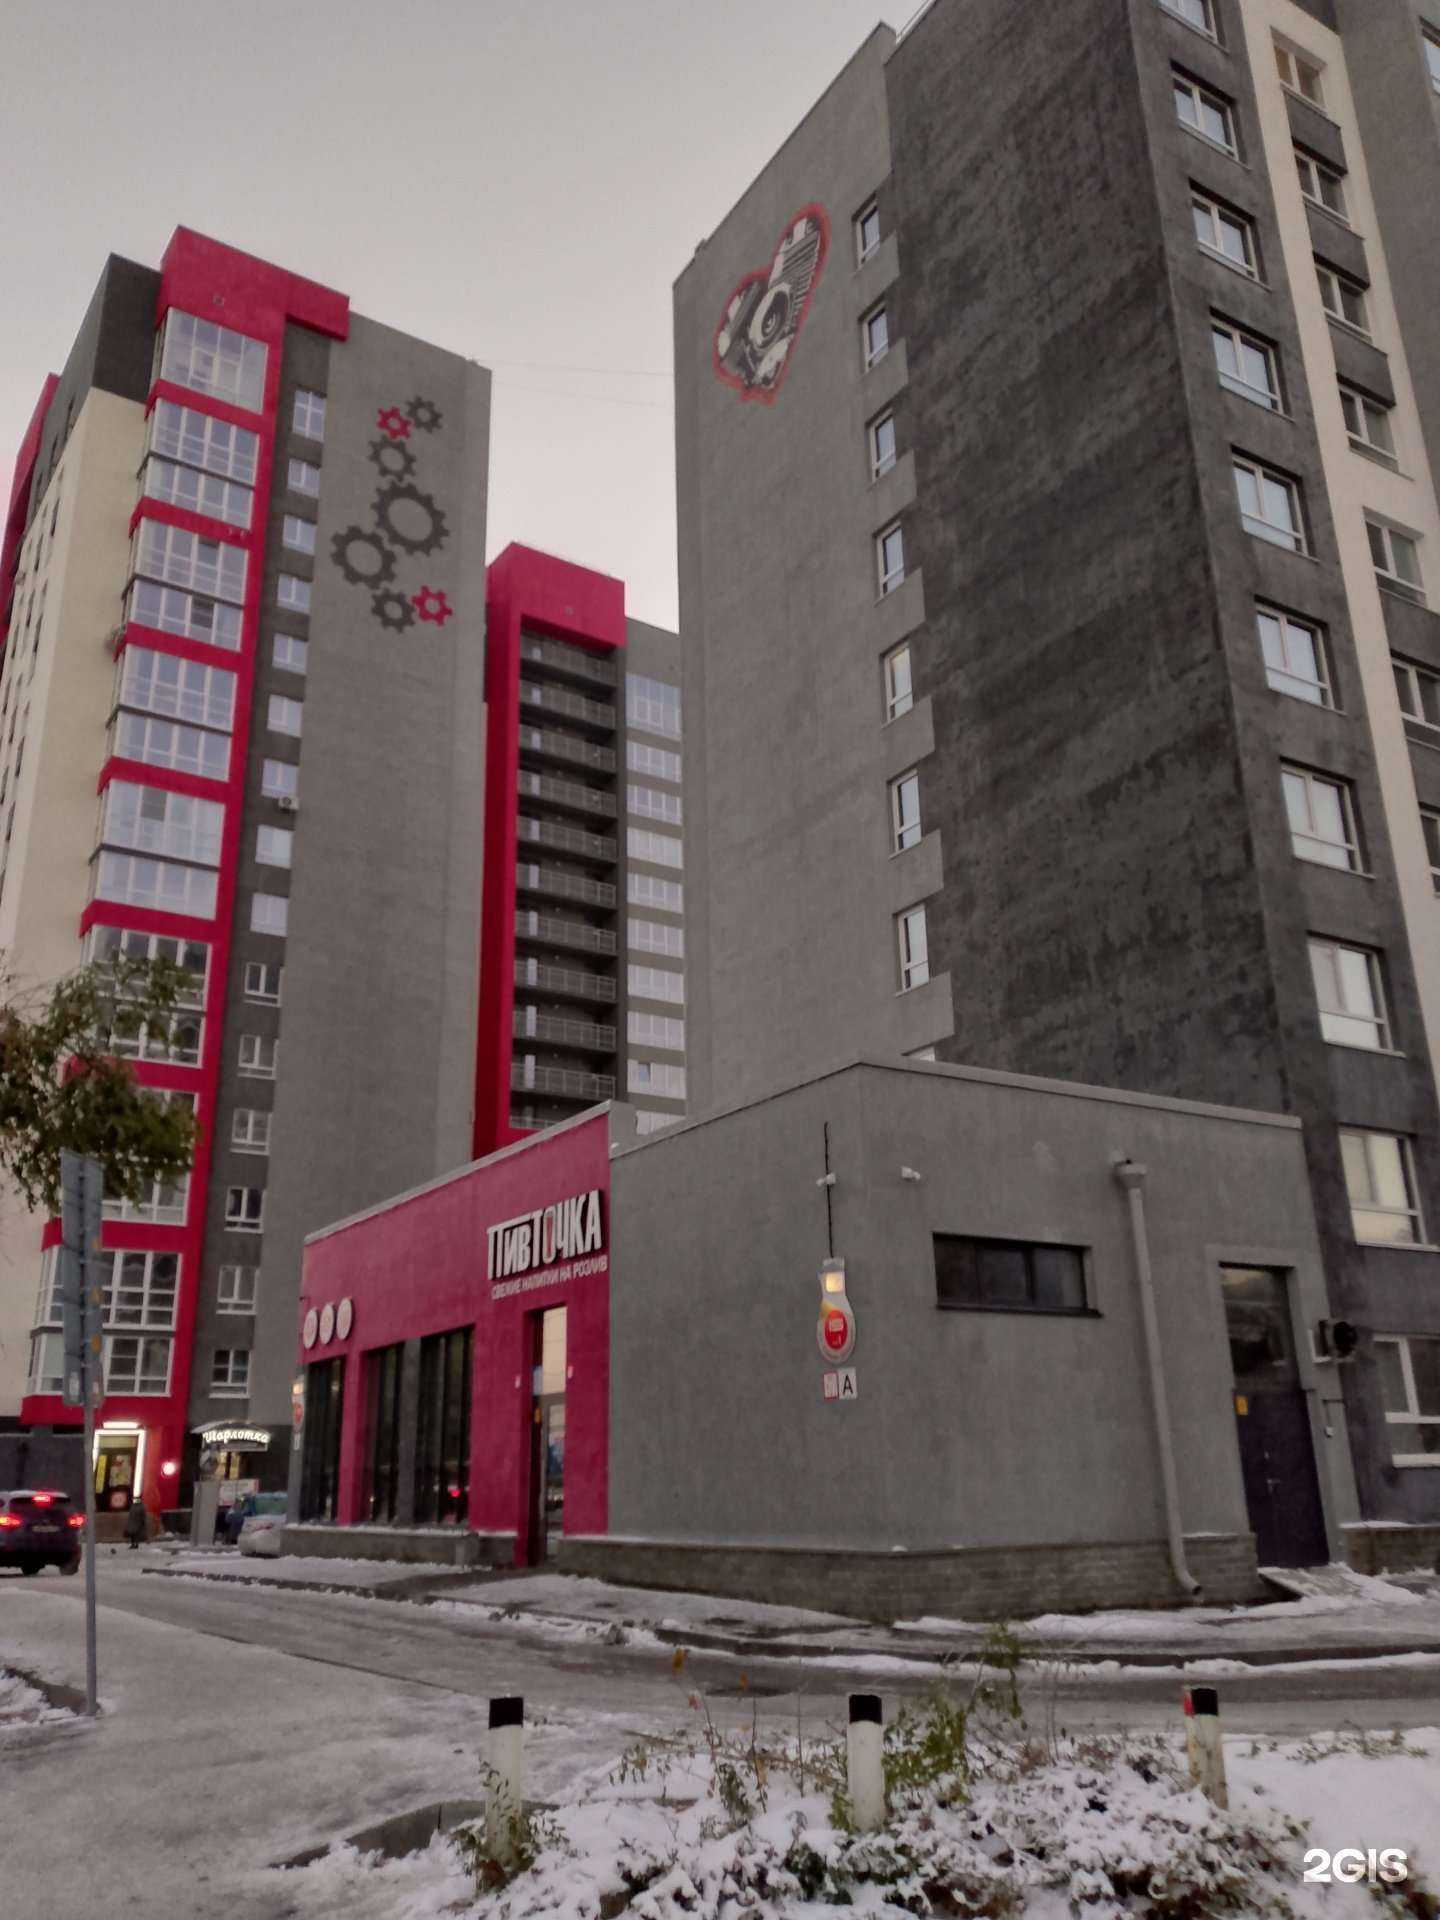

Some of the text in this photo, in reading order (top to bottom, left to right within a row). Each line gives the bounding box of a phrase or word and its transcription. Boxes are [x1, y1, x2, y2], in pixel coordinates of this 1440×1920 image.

[487, 1189, 602, 1280] ПИВТОЧКА
[560, 1265, 572, 1282] НА
[573, 1255, 608, 1280] РОЗЛИВ
[203, 1430, 271, 1445] Шарлотка
